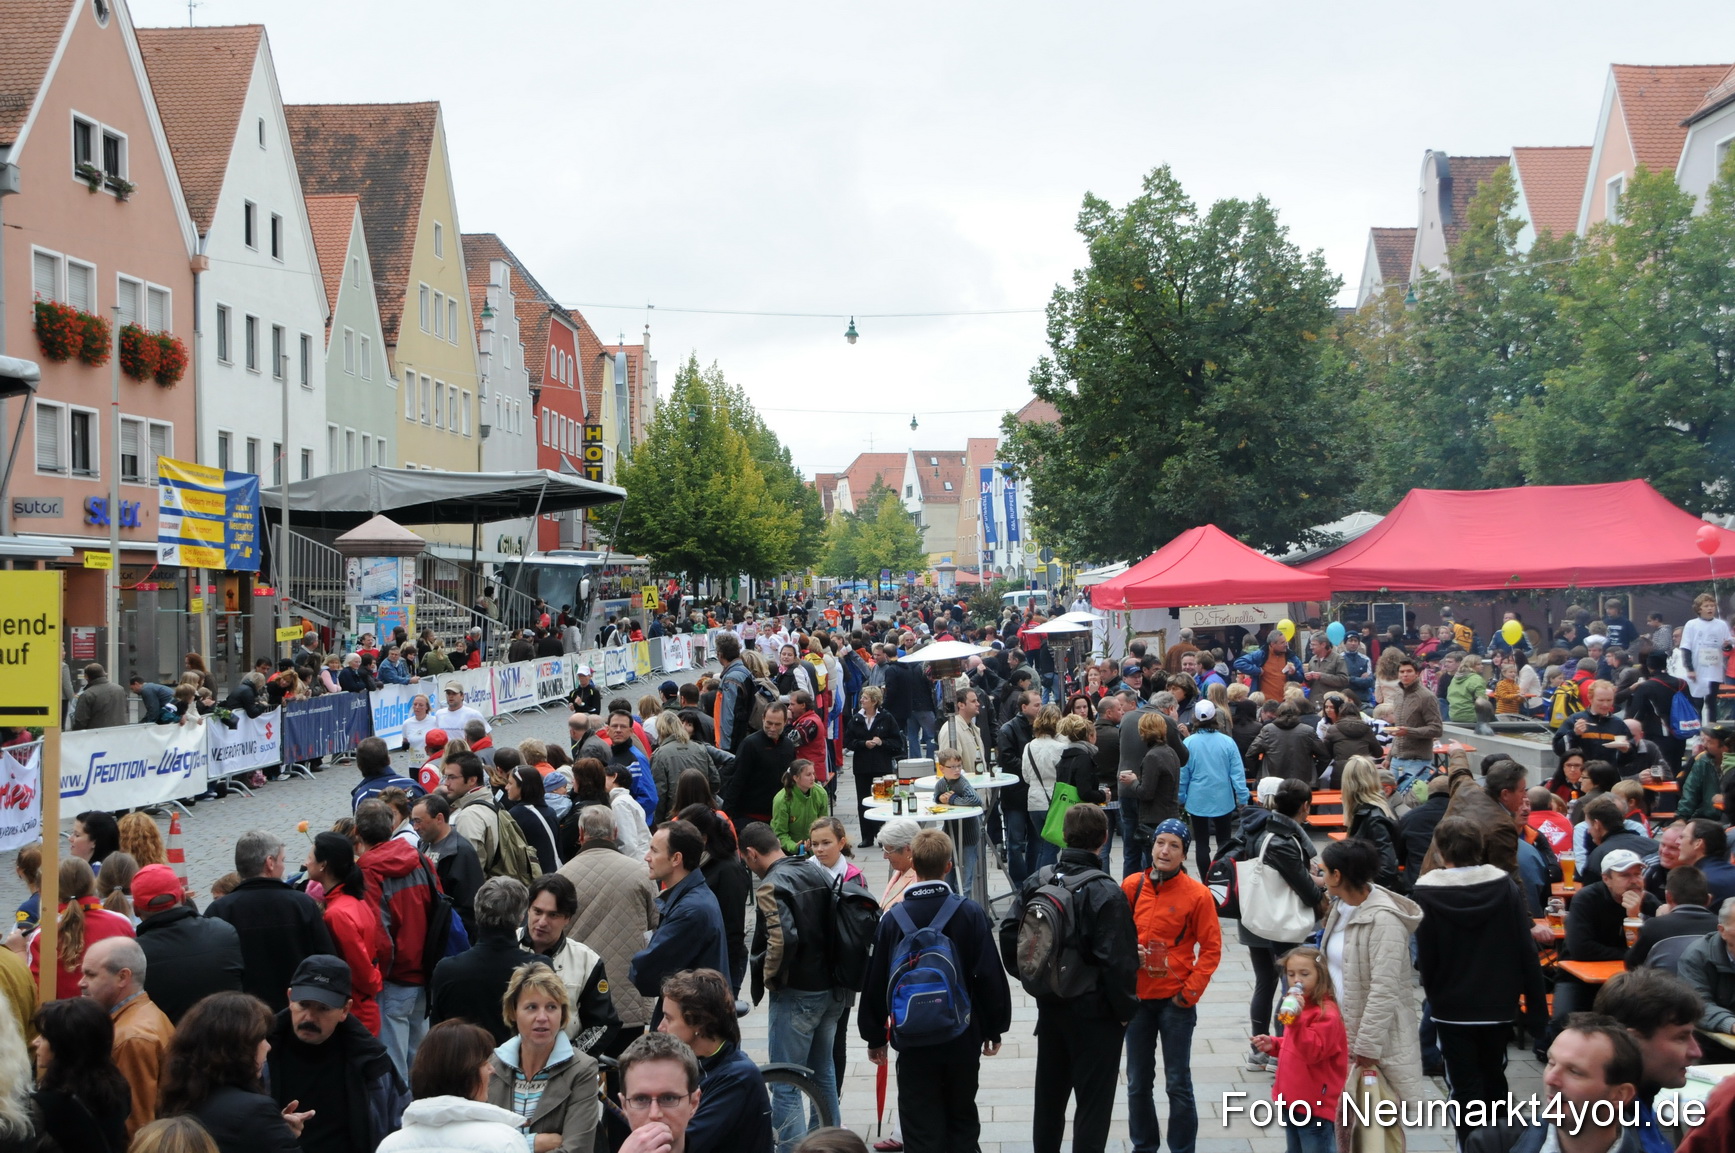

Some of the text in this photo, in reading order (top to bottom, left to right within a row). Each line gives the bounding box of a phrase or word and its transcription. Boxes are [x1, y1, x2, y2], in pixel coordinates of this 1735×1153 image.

[586, 426, 602, 521] HOTL
[14, 500, 59, 514] sutor.
[645, 592, 655, 604] A
[1193, 610, 1255, 626] La Fortunella
[498, 666, 522, 700] MCM
[912, 887, 935, 897] adidas
